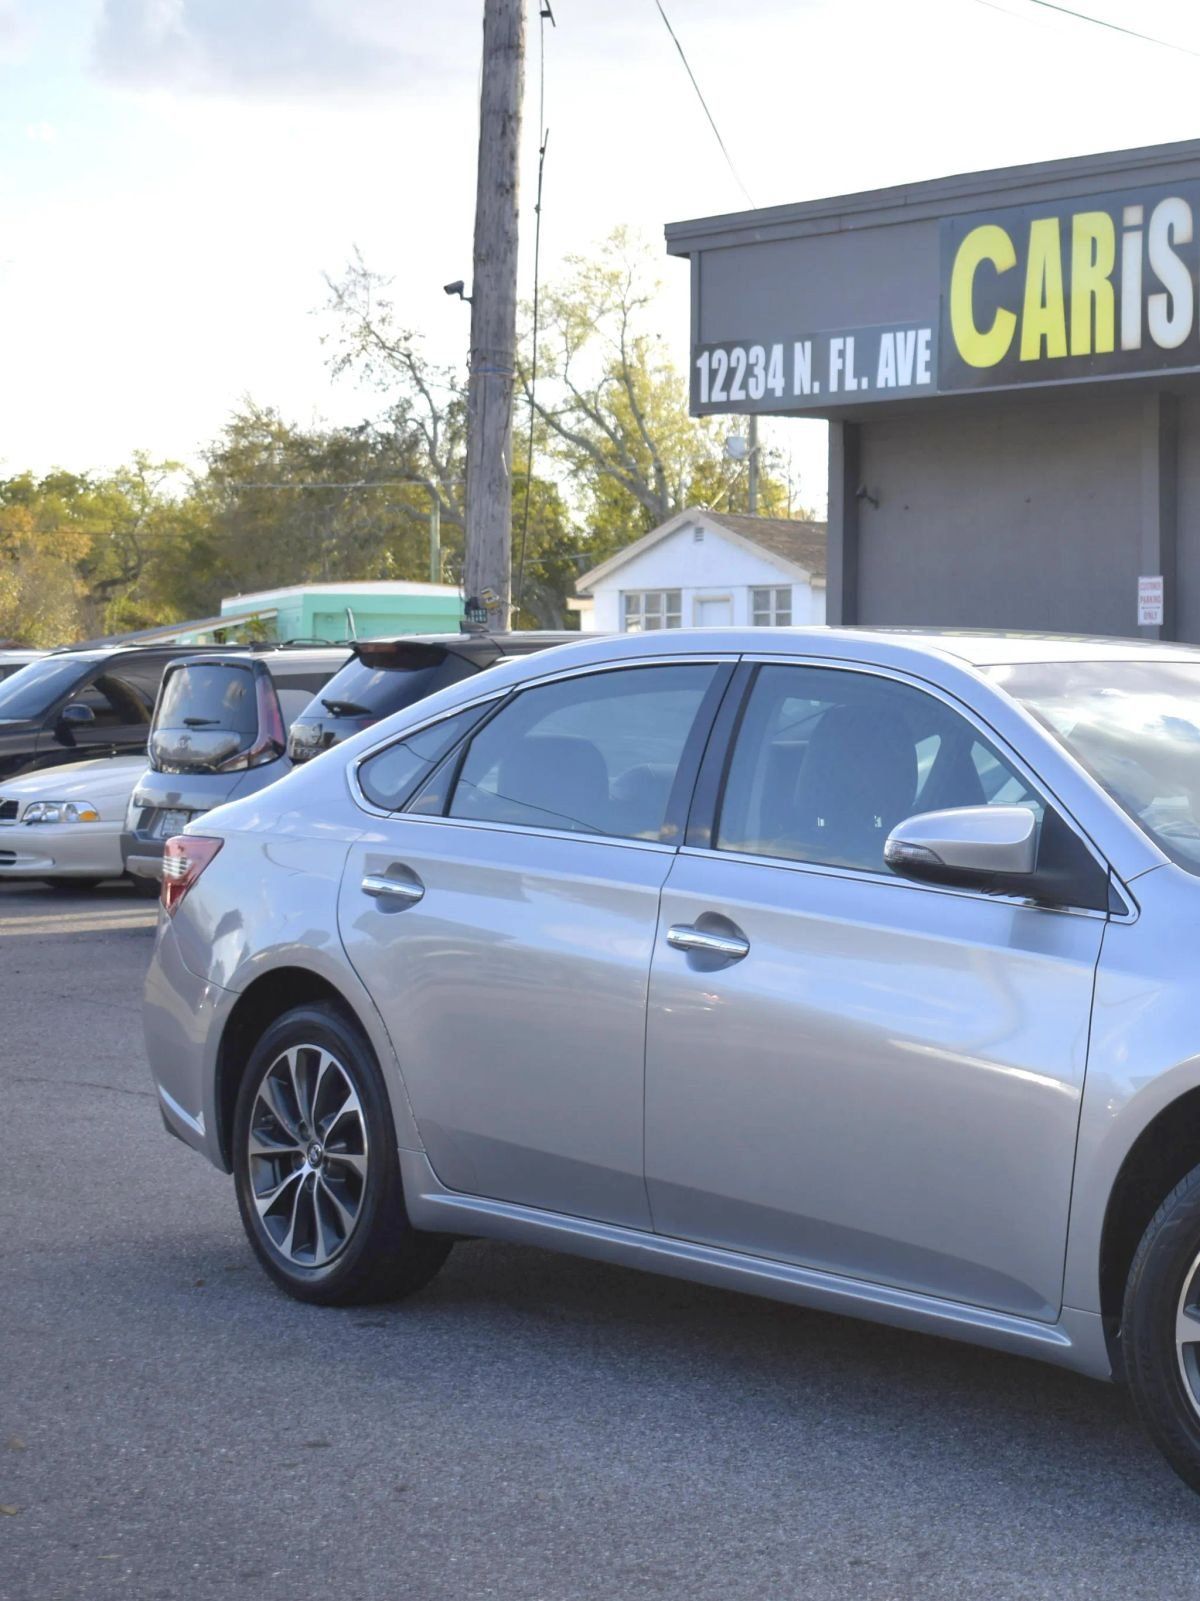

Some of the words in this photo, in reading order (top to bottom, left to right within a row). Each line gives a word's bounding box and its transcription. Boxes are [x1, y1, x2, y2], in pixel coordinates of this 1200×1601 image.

[697, 345, 784, 403] 12234
[793, 341, 819, 395] N.
[829, 337, 867, 391] FL.
[877, 328, 931, 387] AVE
